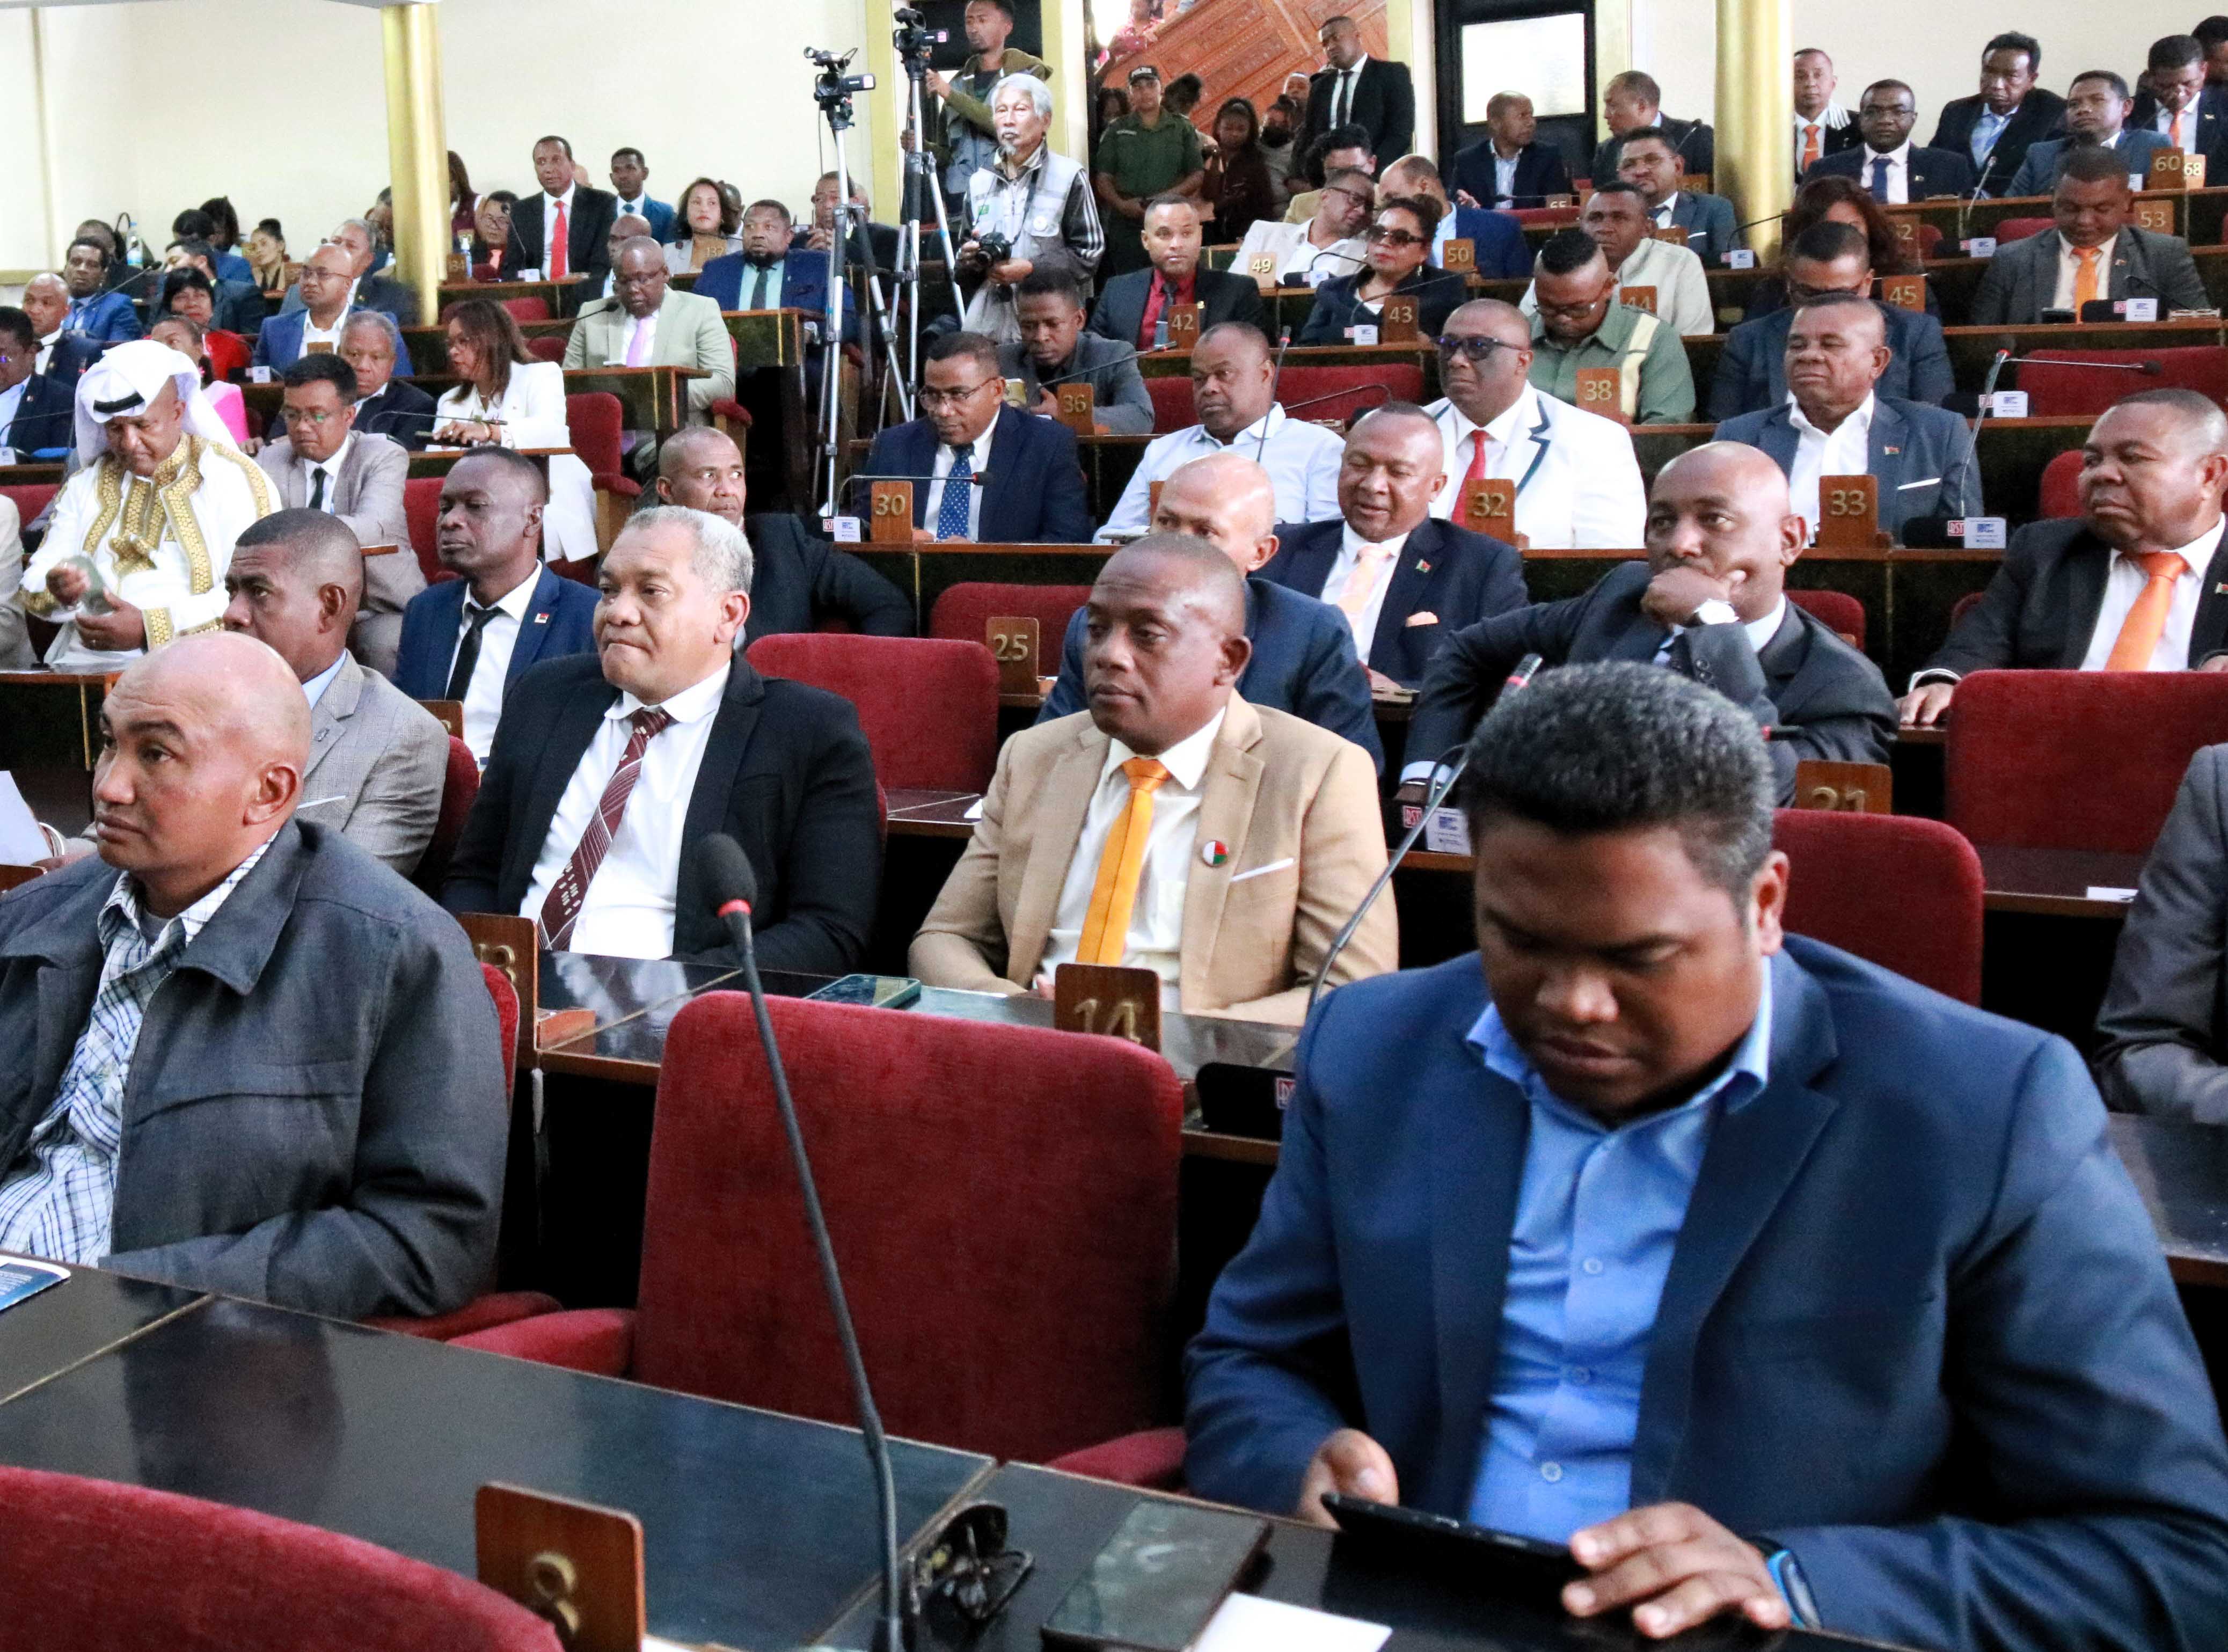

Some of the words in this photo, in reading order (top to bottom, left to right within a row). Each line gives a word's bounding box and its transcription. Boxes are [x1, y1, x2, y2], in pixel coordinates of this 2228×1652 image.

[2156, 156, 2181, 172] 60
[2141, 211, 2166, 228] 53
[1448, 247, 1469, 263] 50
[1252, 259, 1273, 273] 49
[1889, 285, 1917, 305] 45
[1172, 314, 1195, 331] 42
[1389, 306, 1413, 323] 43
[1584, 379, 1612, 401] 38
[1063, 394, 1087, 413] 36
[875, 494, 906, 516] 30
[1473, 493, 1507, 517] 32
[1830, 489, 1867, 516] 33
[994, 634, 1029, 661] 25
[1073, 998, 1143, 1044] 14
